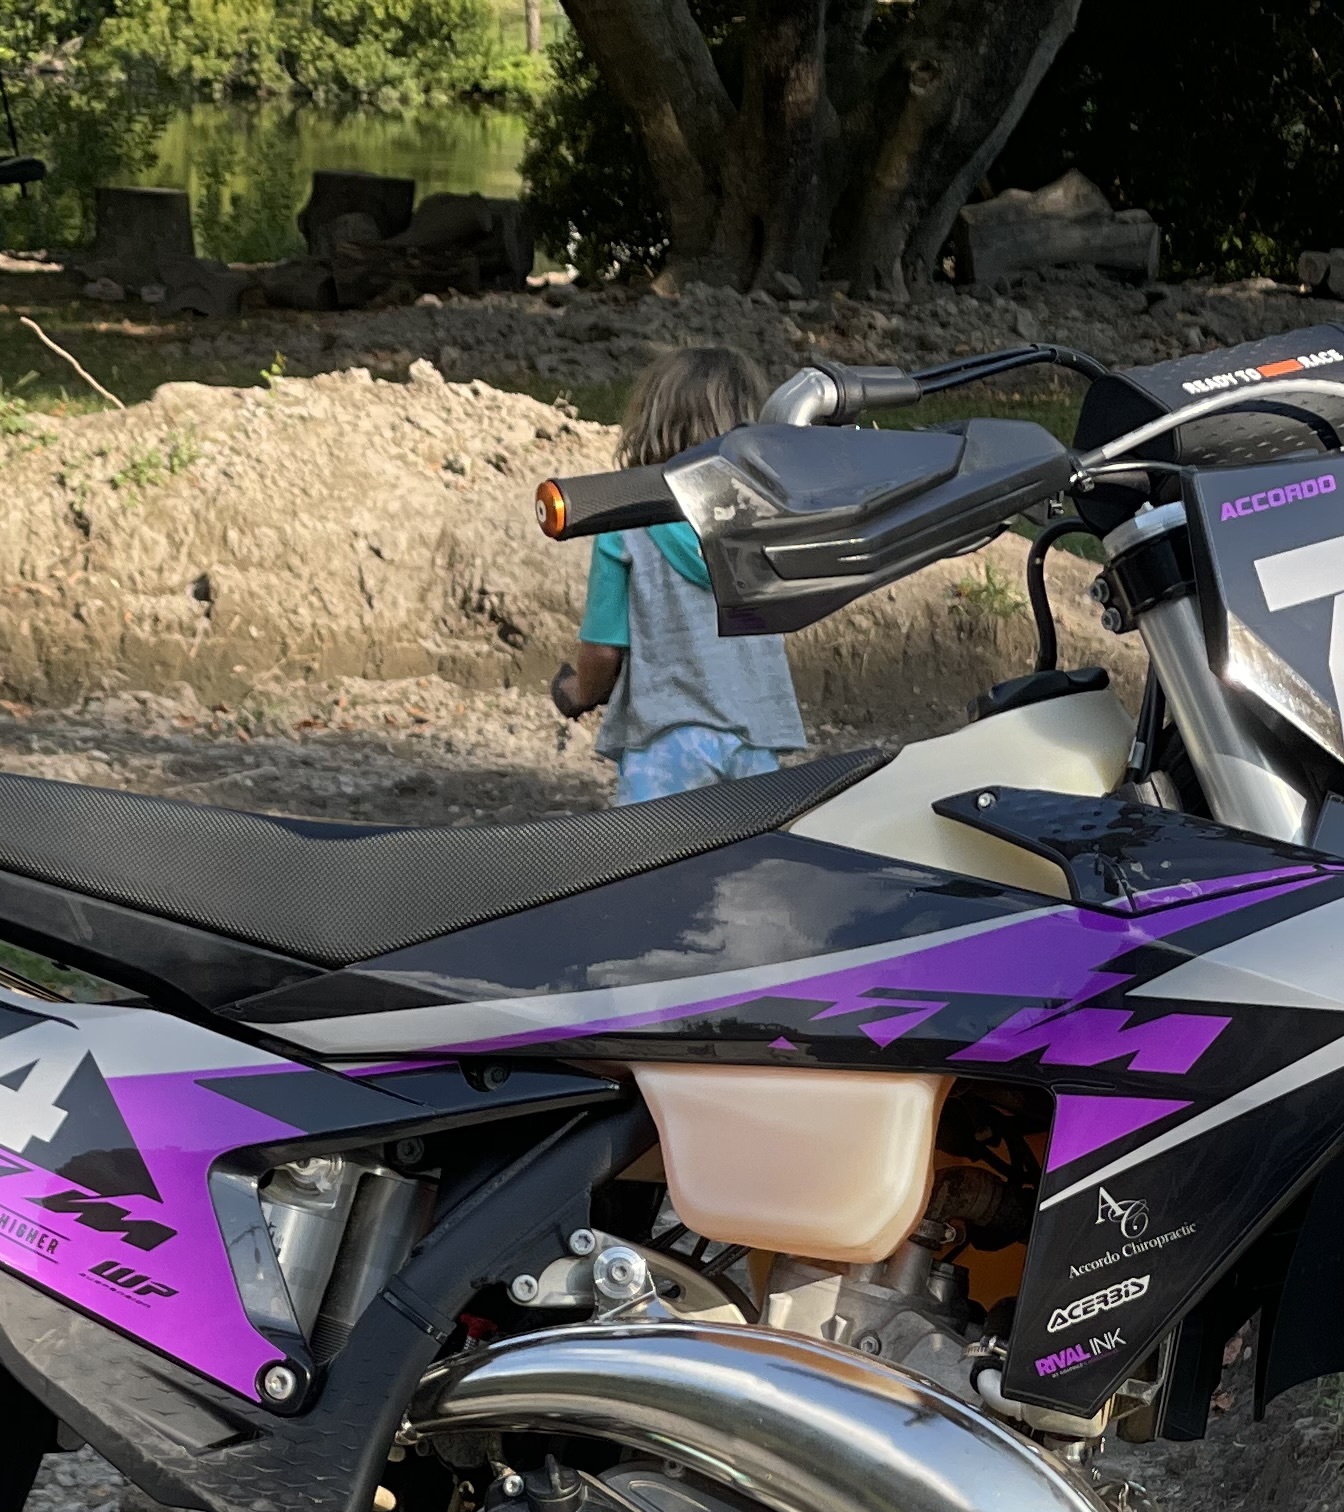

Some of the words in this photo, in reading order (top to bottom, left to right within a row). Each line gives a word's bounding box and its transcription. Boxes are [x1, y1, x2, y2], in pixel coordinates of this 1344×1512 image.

[1182, 372, 1238, 394] READY
[1235, 367, 1262, 382] TO
[1296, 348, 1344, 368] RACE
[1220, 474, 1337, 521] ACCORDO
[1068, 1251, 1121, 1280] Accordo
[1122, 1221, 1197, 1258] Chiropractic
[87, 1260, 179, 1298] WP
[1035, 1344, 1092, 1377] RIVAL
[1089, 1327, 1127, 1355] INK
